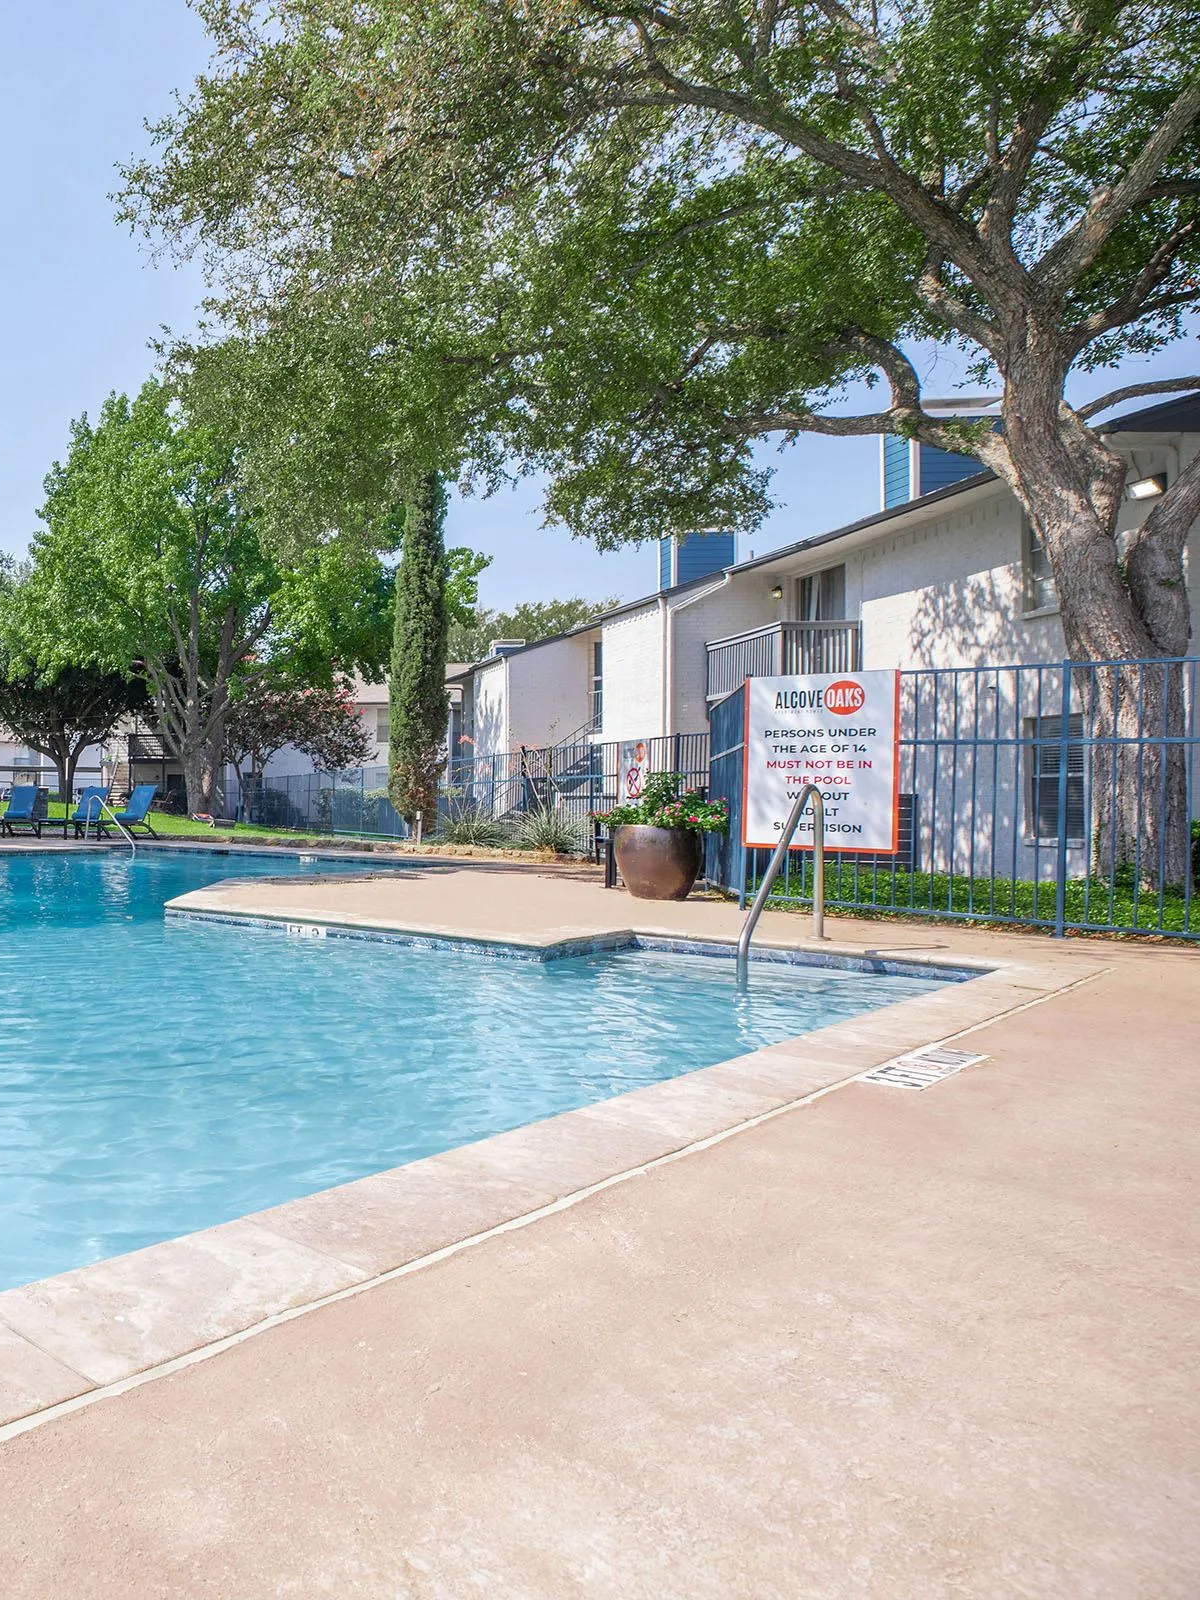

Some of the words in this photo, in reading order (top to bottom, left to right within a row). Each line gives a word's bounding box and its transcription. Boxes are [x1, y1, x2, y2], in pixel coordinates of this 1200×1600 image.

[775, 690, 823, 709] ALCOVE
[826, 688, 862, 708] OAKS
[764, 729, 824, 738] PERSONS
[828, 728, 877, 737] UNDER
[772, 745, 796, 753] THE
[800, 744, 826, 753] AGE
[831, 744, 849, 753] OF
[853, 744, 867, 753] 14
[766, 760, 801, 769] MUST
[805, 760, 833, 769] NOT
[837, 760, 854, 769] BE
[858, 760, 872, 769] IN
[785, 776, 809, 784] THE
[814, 776, 851, 785] POOL
[786, 791, 850, 800] WOUT
[799, 807, 839, 816] DLT
